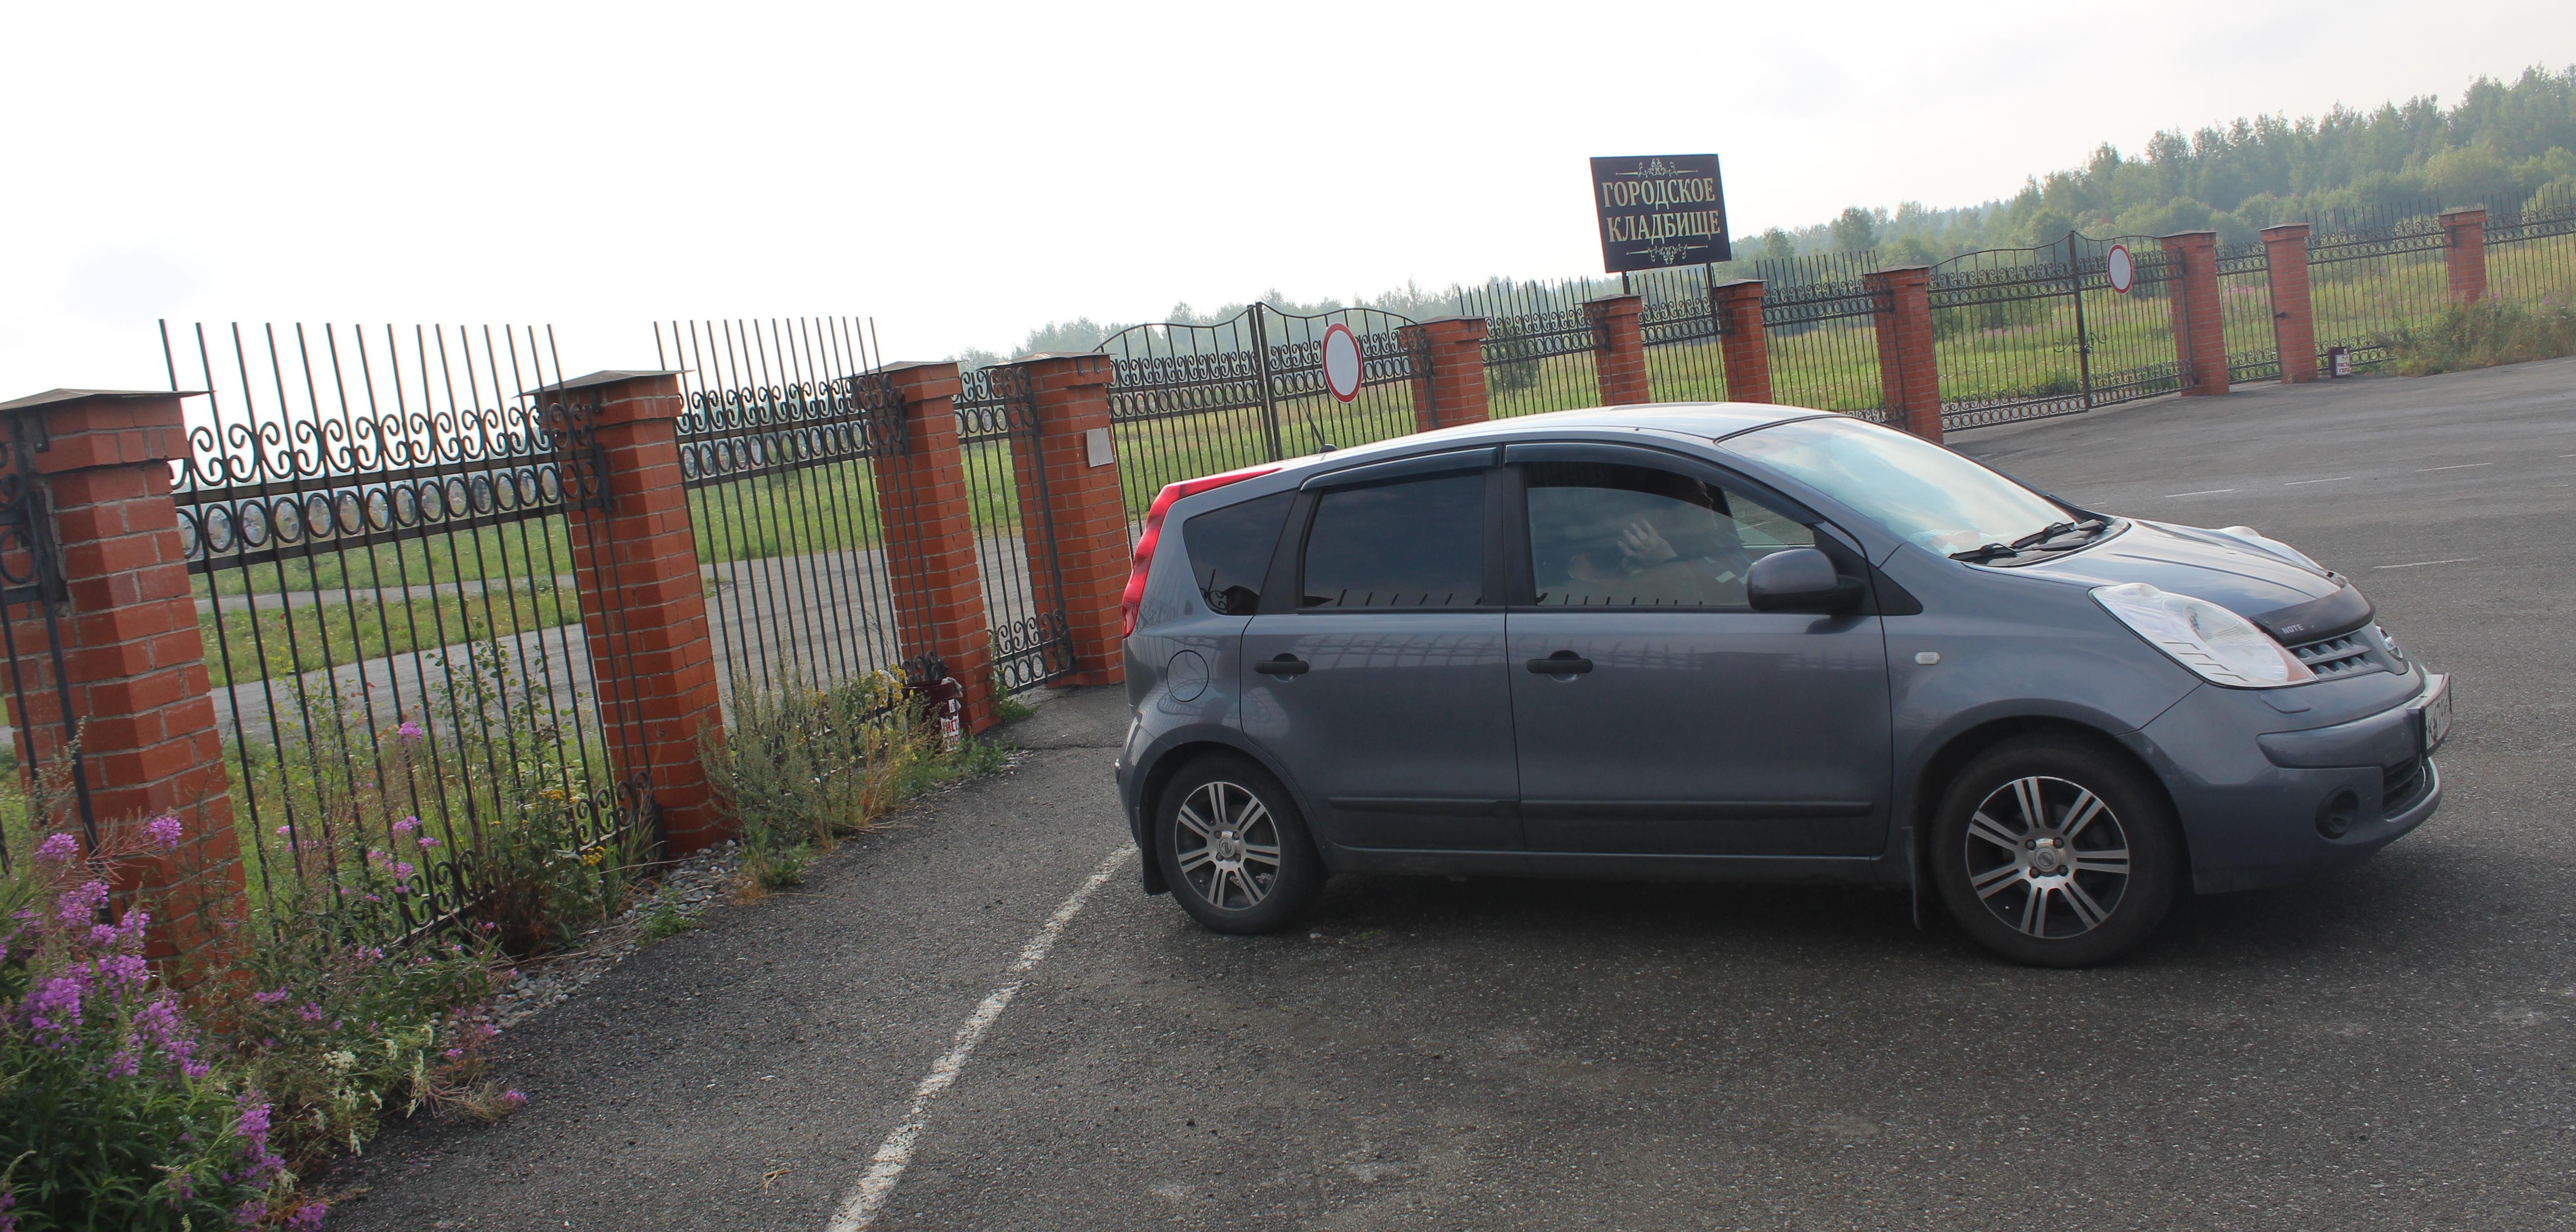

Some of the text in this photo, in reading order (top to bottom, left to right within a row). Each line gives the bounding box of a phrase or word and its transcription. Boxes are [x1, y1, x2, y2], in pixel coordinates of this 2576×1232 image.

[1602, 178, 1715, 210] ГОРОДСКОЕ
[1607, 210, 1720, 245] КЛАДБИЩЕ
[2281, 624, 2304, 634] NOTE
